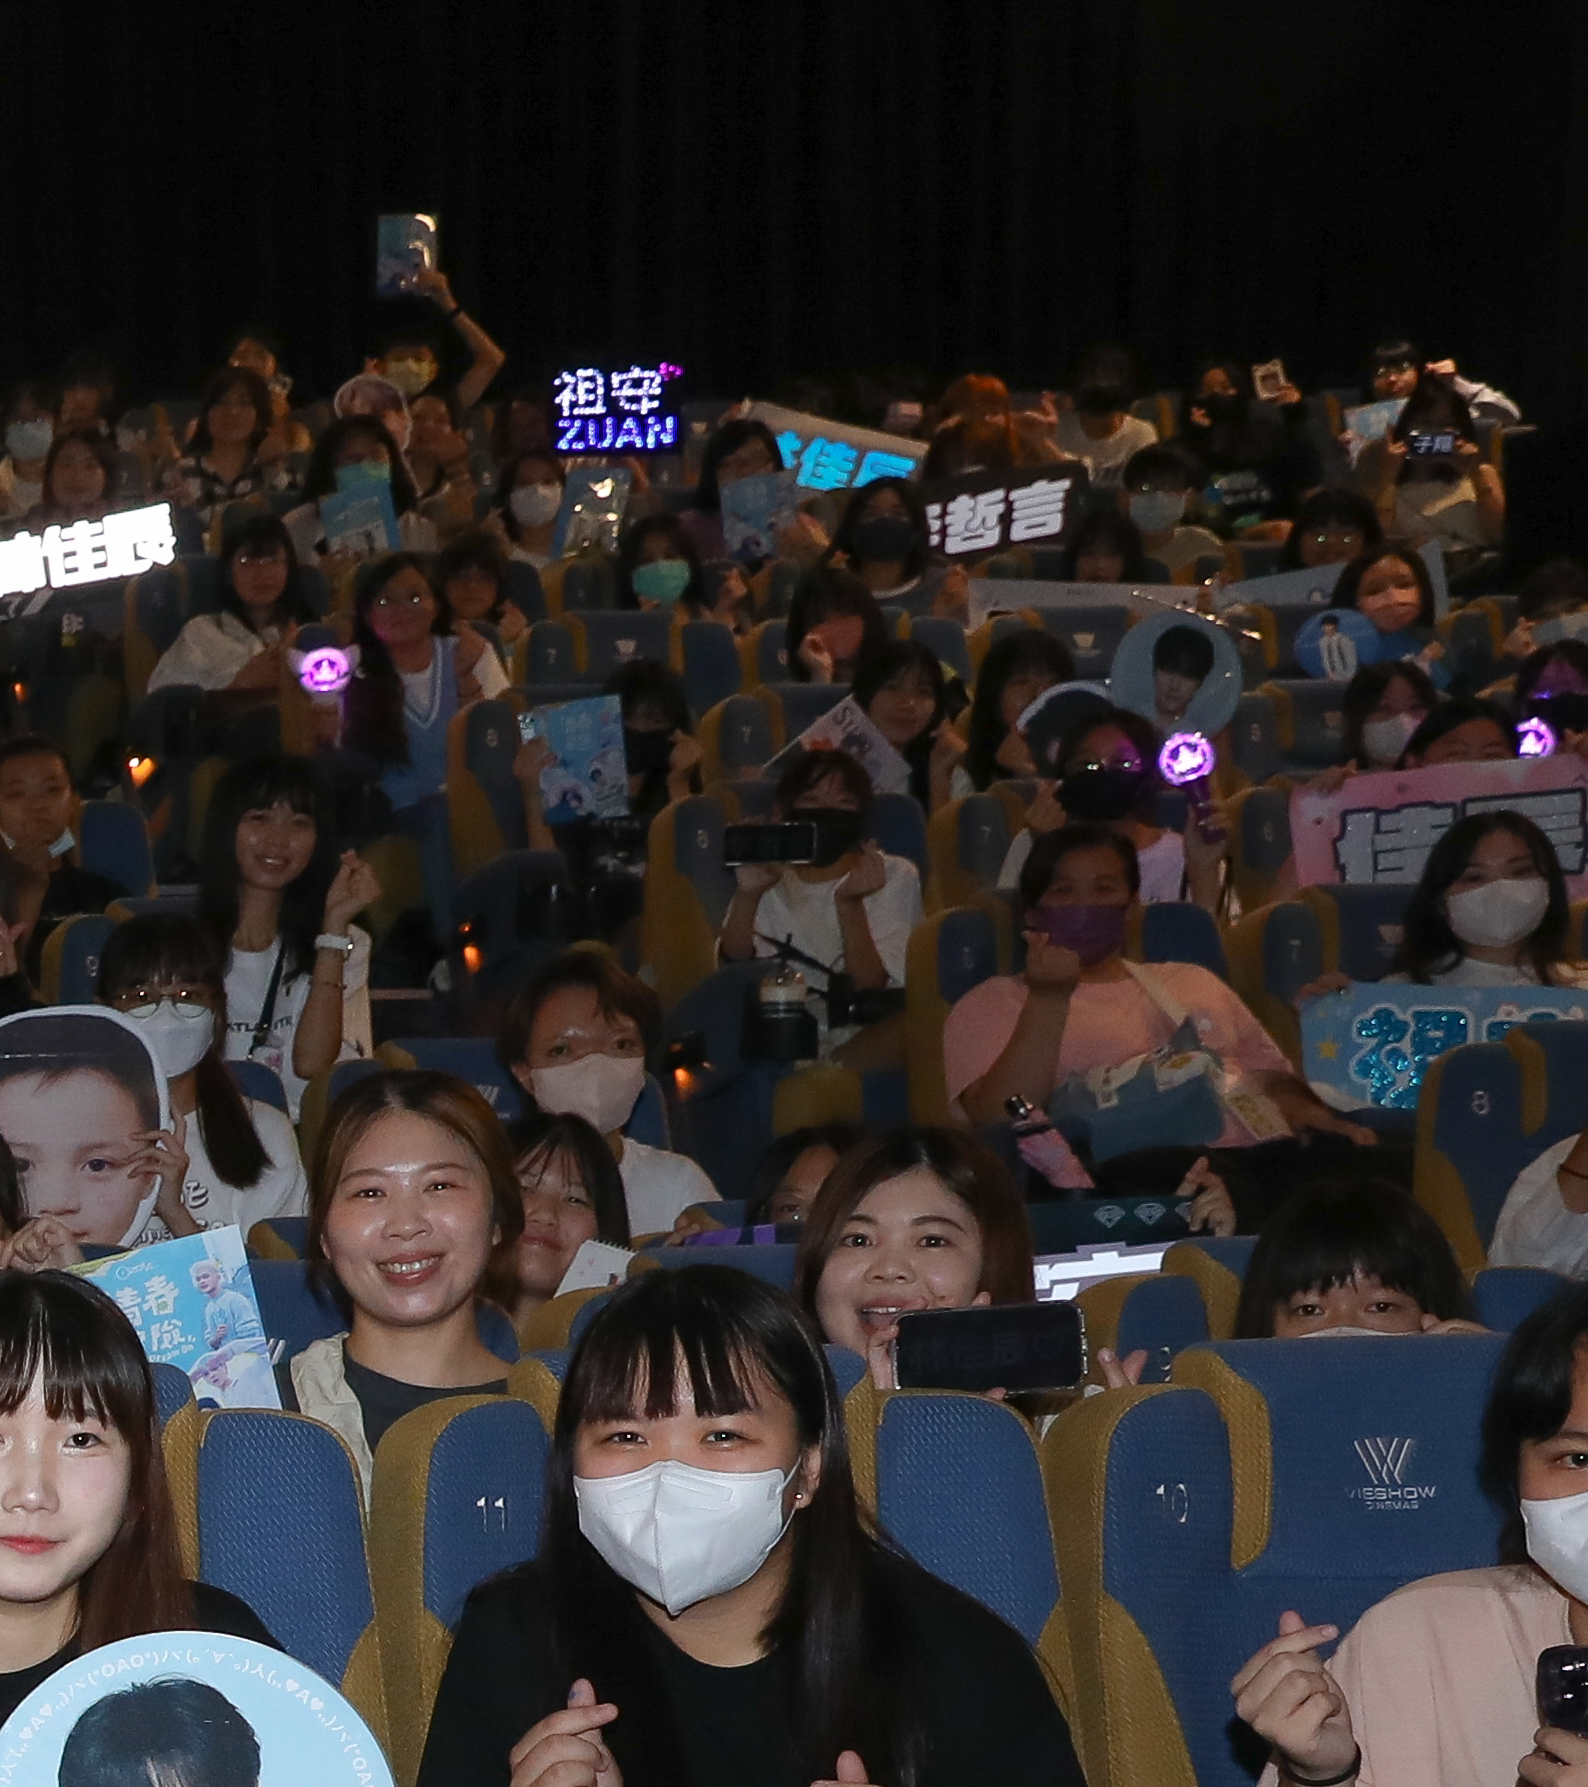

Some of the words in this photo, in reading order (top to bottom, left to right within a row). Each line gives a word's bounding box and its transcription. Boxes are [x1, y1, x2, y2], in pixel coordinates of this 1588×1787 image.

[554, 364, 663, 416] 祖安
[555, 416, 677, 450] ZUAN
[1471, 1090, 1491, 1115] 8
[476, 1497, 506, 1532] 11
[1156, 1483, 1189, 1524] 10
